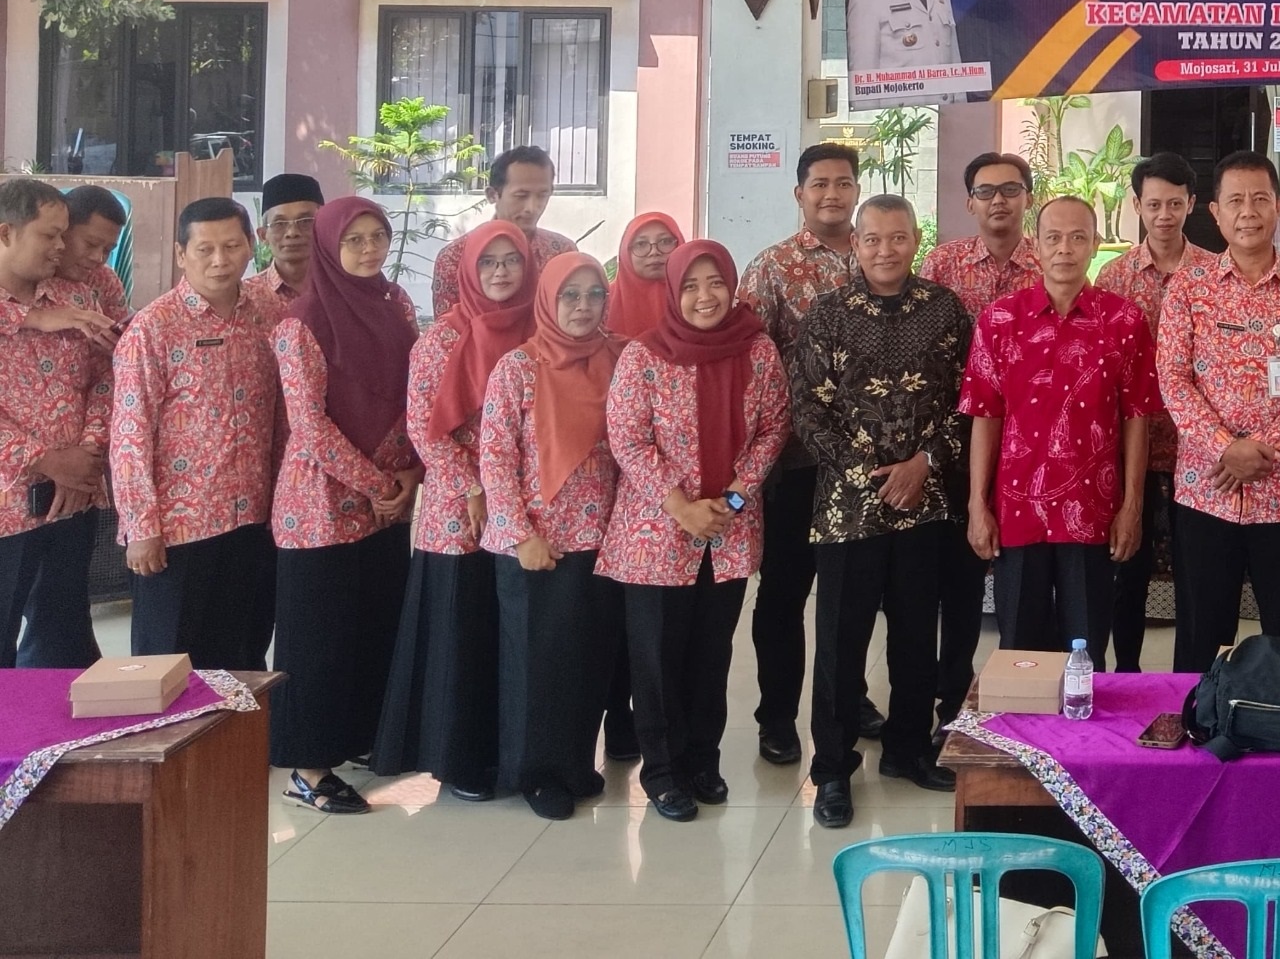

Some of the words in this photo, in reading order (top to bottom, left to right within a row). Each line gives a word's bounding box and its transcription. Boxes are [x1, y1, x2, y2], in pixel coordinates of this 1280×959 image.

[1086, 2, 1266, 27] KECAMATAN
[1178, 32, 1263, 50] TAHUN
[1180, 62, 1240, 76] Mojosari,
[1244, 62, 1258, 74] 31
[855, 84, 882, 95] Bupati
[883, 81, 924, 94] Mojokerto
[729, 134, 771, 142] TEMPAT
[729, 142, 775, 150] SMOKING
